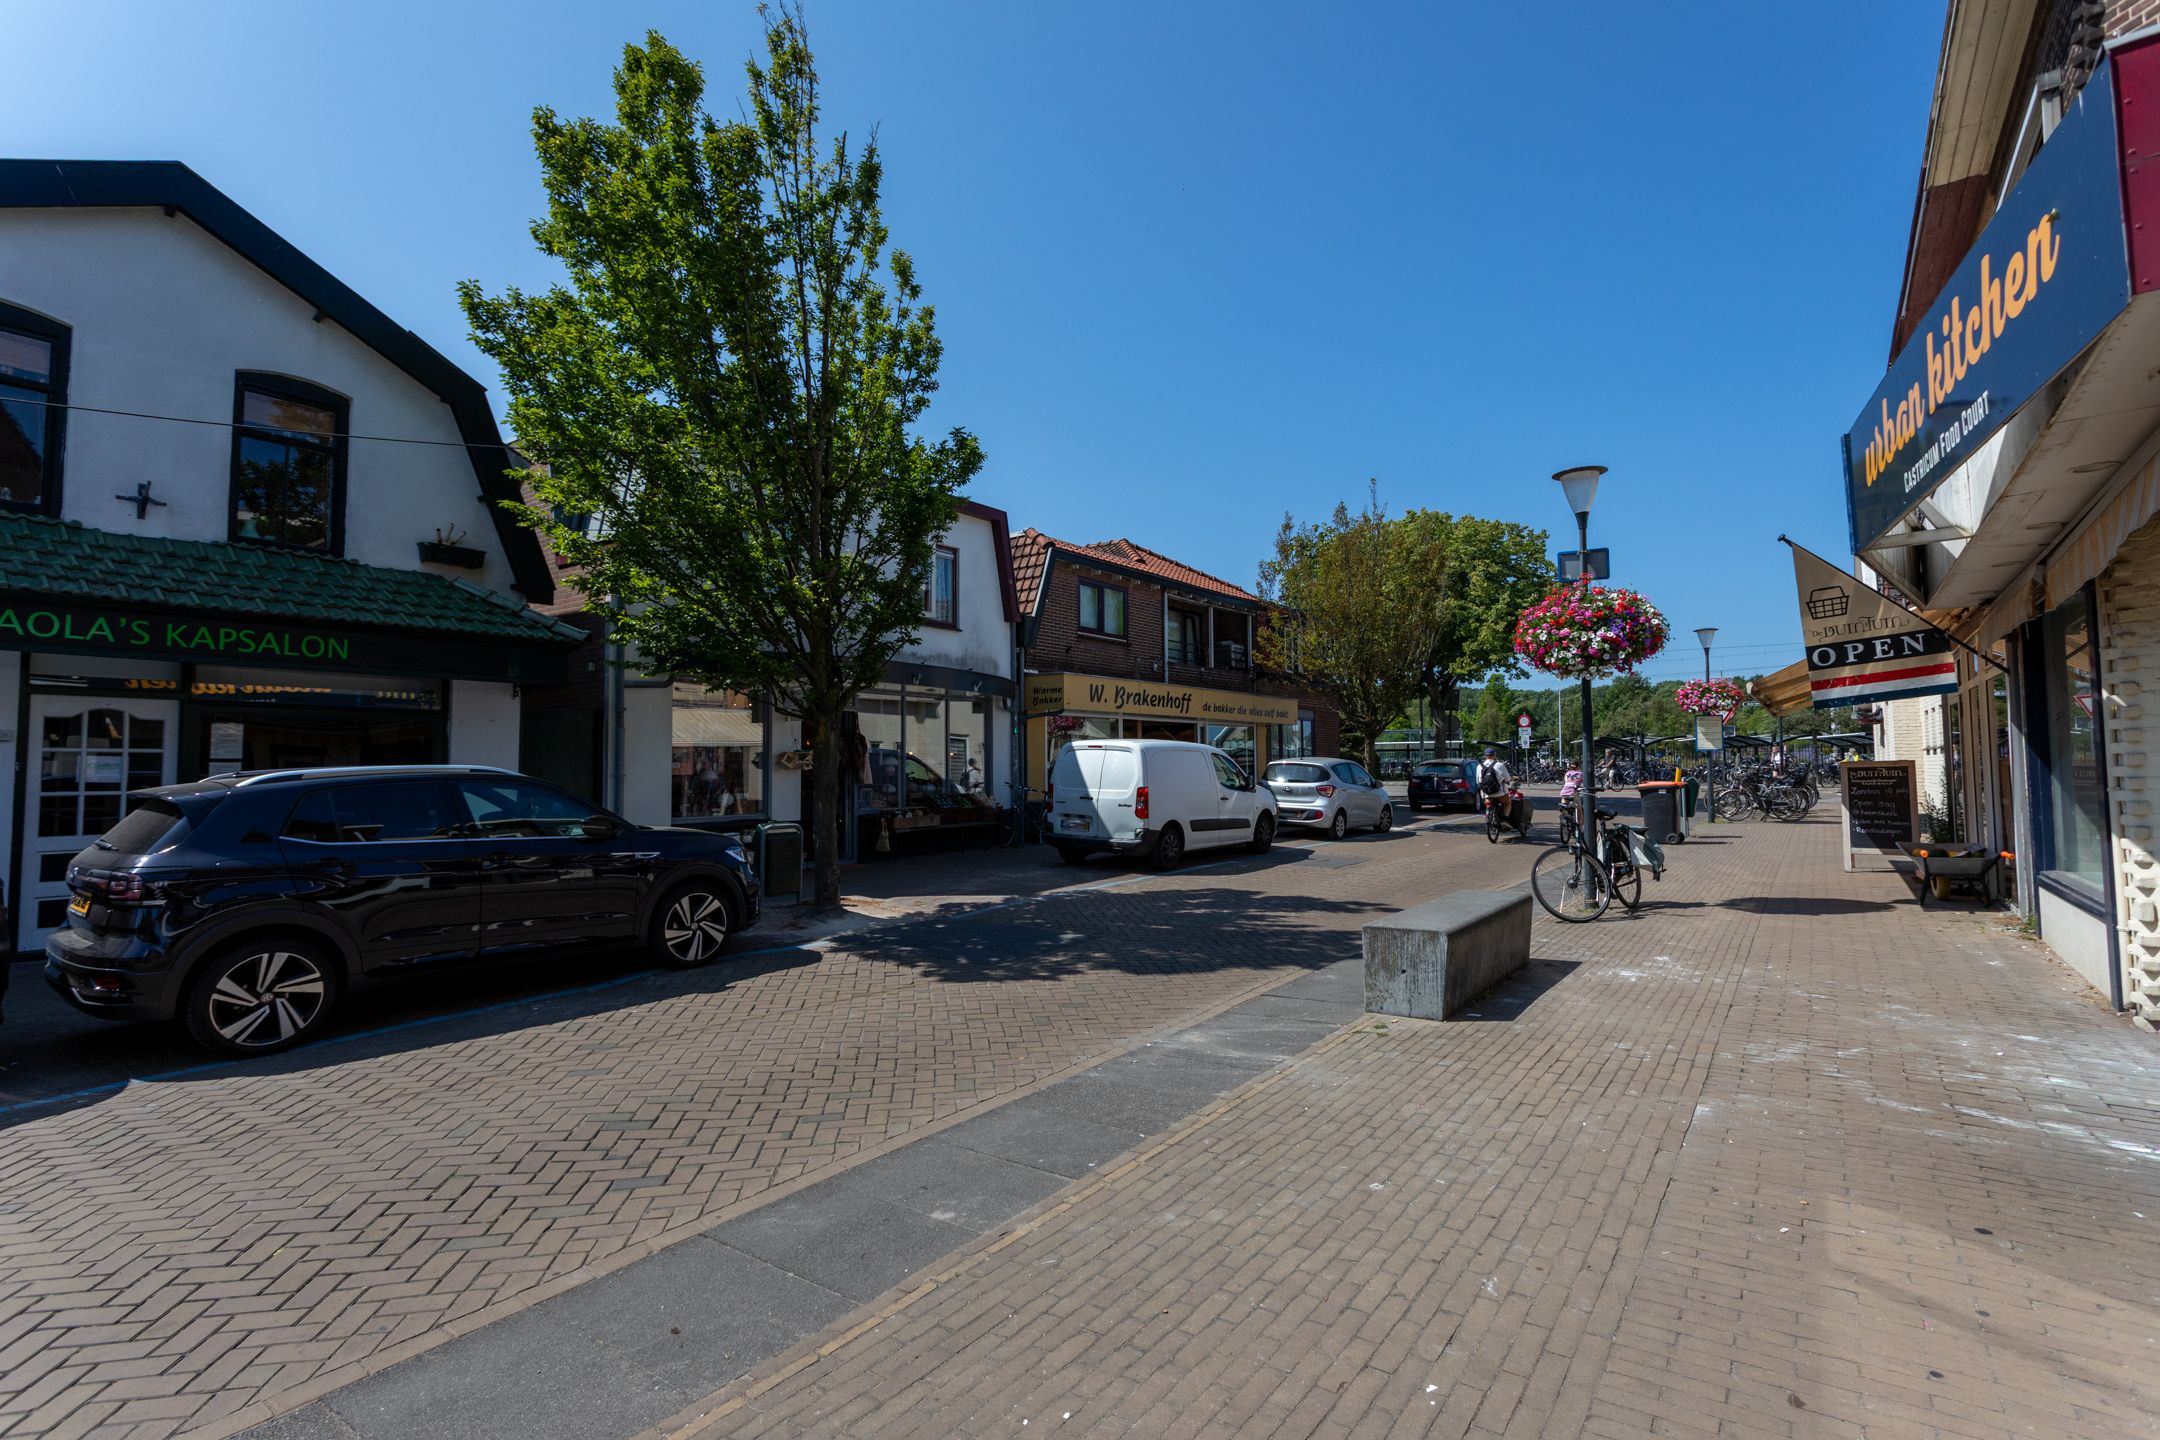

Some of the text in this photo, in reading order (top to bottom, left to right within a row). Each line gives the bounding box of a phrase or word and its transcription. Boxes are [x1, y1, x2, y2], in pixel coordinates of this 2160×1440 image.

[1865, 213, 2060, 487] urban kitchen
[1903, 390, 1989, 494] CASTRICUM FOOD COURT
[166, 623, 348, 660] KAPSALON
[1812, 633, 1925, 667] OPEN
[1033, 696, 1062, 705] Bakker
[1089, 684, 1192, 714] W. Brakenhoff
[1202, 701, 1211, 712] de
[1213, 703, 1235, 714] bakker
[1237, 705, 1247, 715] die
[1249, 706, 1263, 717] alles
